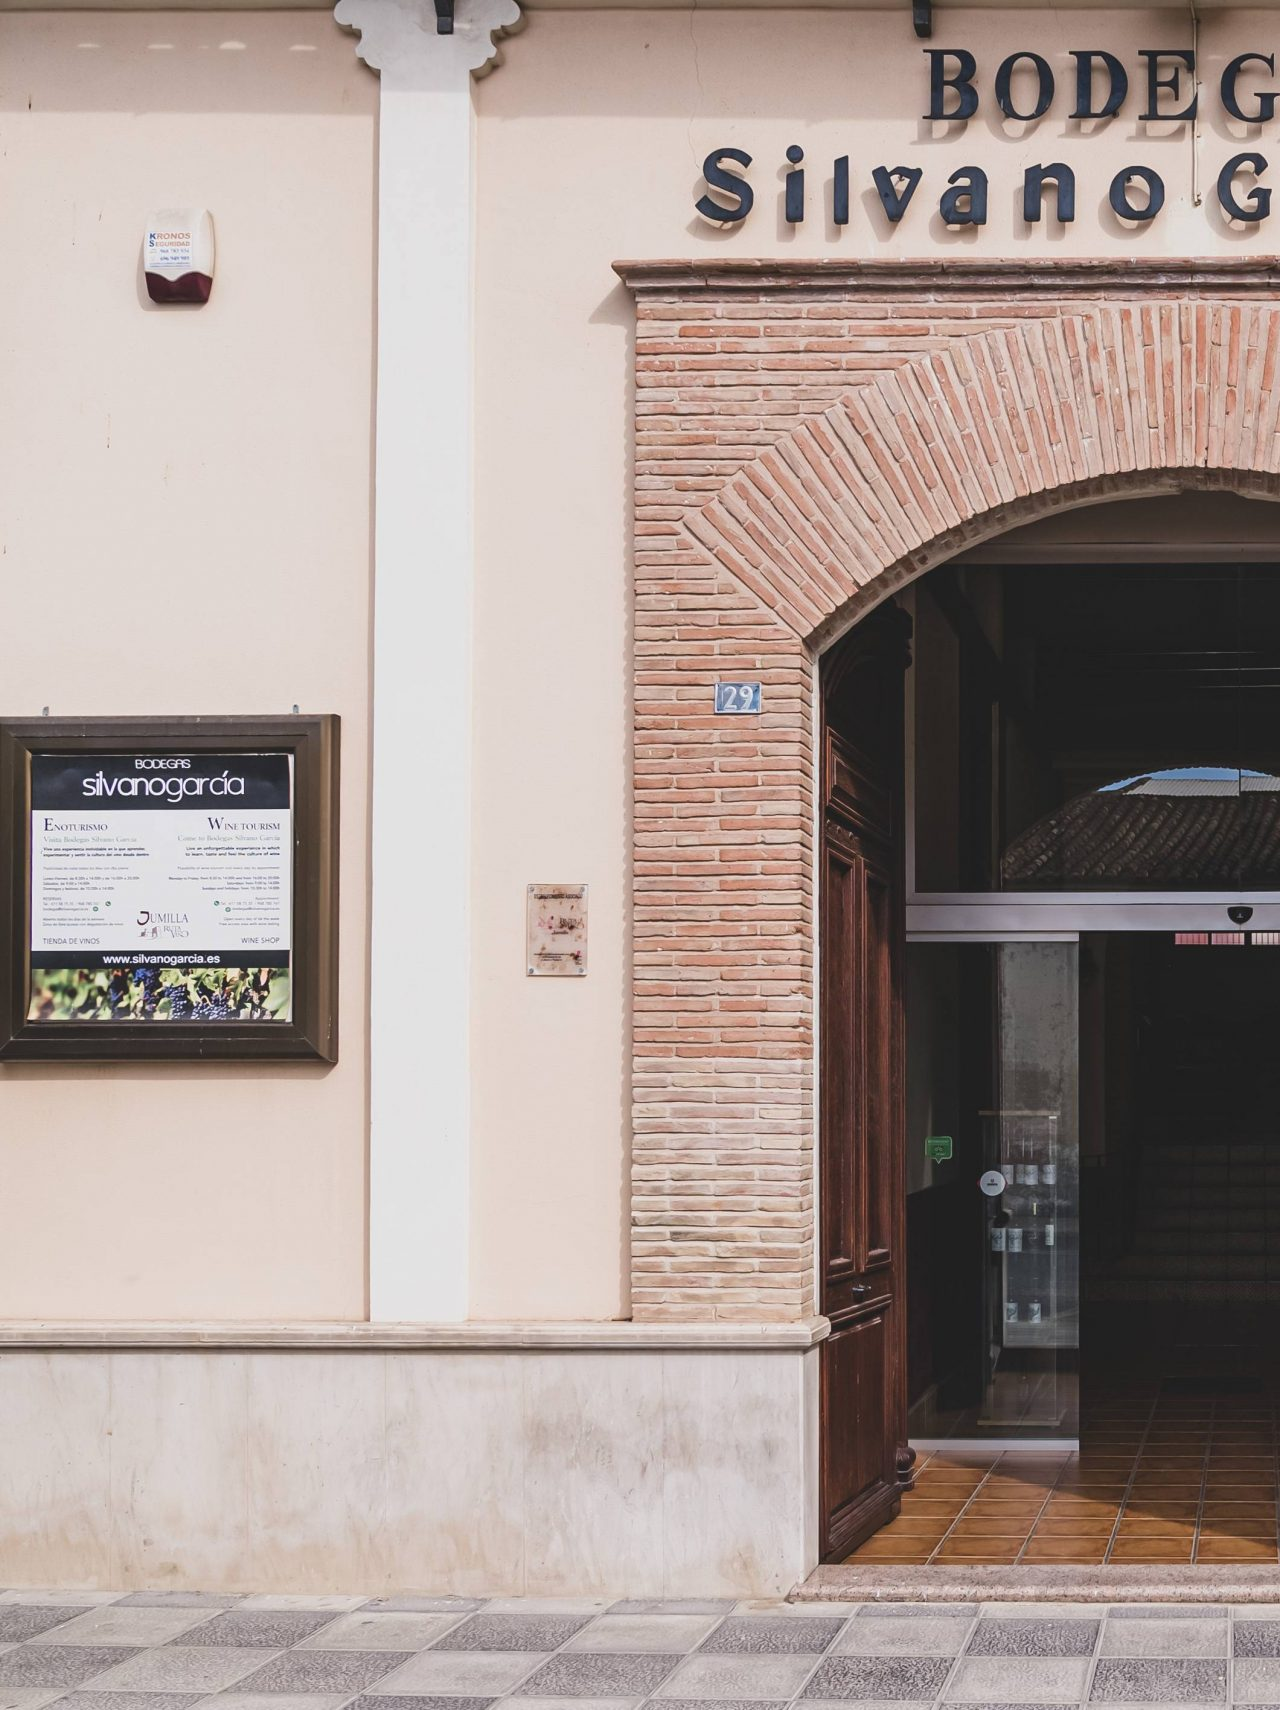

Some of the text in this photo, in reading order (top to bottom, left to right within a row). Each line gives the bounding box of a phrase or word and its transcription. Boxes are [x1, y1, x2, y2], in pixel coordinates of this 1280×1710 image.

[695, 144, 1165, 226] Silvano
[723, 685, 753, 710] 29
[135, 758, 191, 769] BODEGAS
[82, 770, 245, 803] silvanogarcía
[44, 817, 108, 832] ENOTURISMO
[207, 816, 239, 830] WINE
[137, 911, 188, 925] JUMILLA
[103, 954, 220, 965] www.silvanogarcia.es
